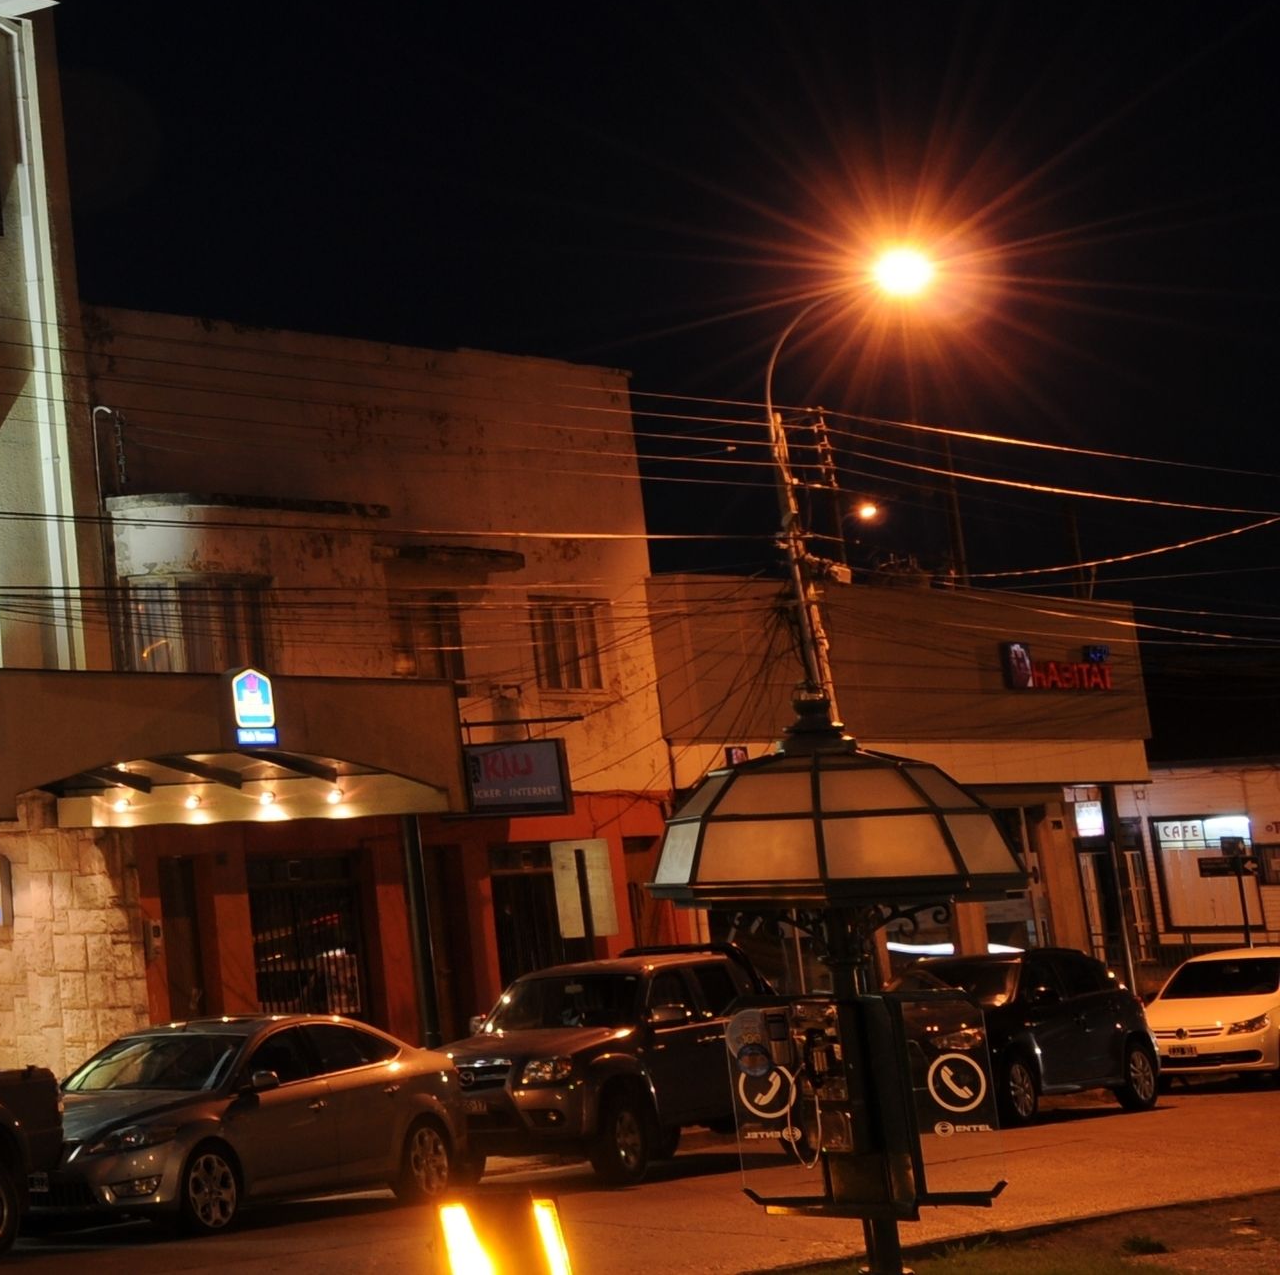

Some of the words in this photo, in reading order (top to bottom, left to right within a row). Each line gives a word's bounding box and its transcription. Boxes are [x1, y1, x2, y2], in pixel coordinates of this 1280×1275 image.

[1032, 661, 1112, 690] HABITAT
[509, 786, 557, 798] INTERNET
[1163, 825, 1199, 838] CAFE
[955, 1125, 993, 1133] ENTEL
